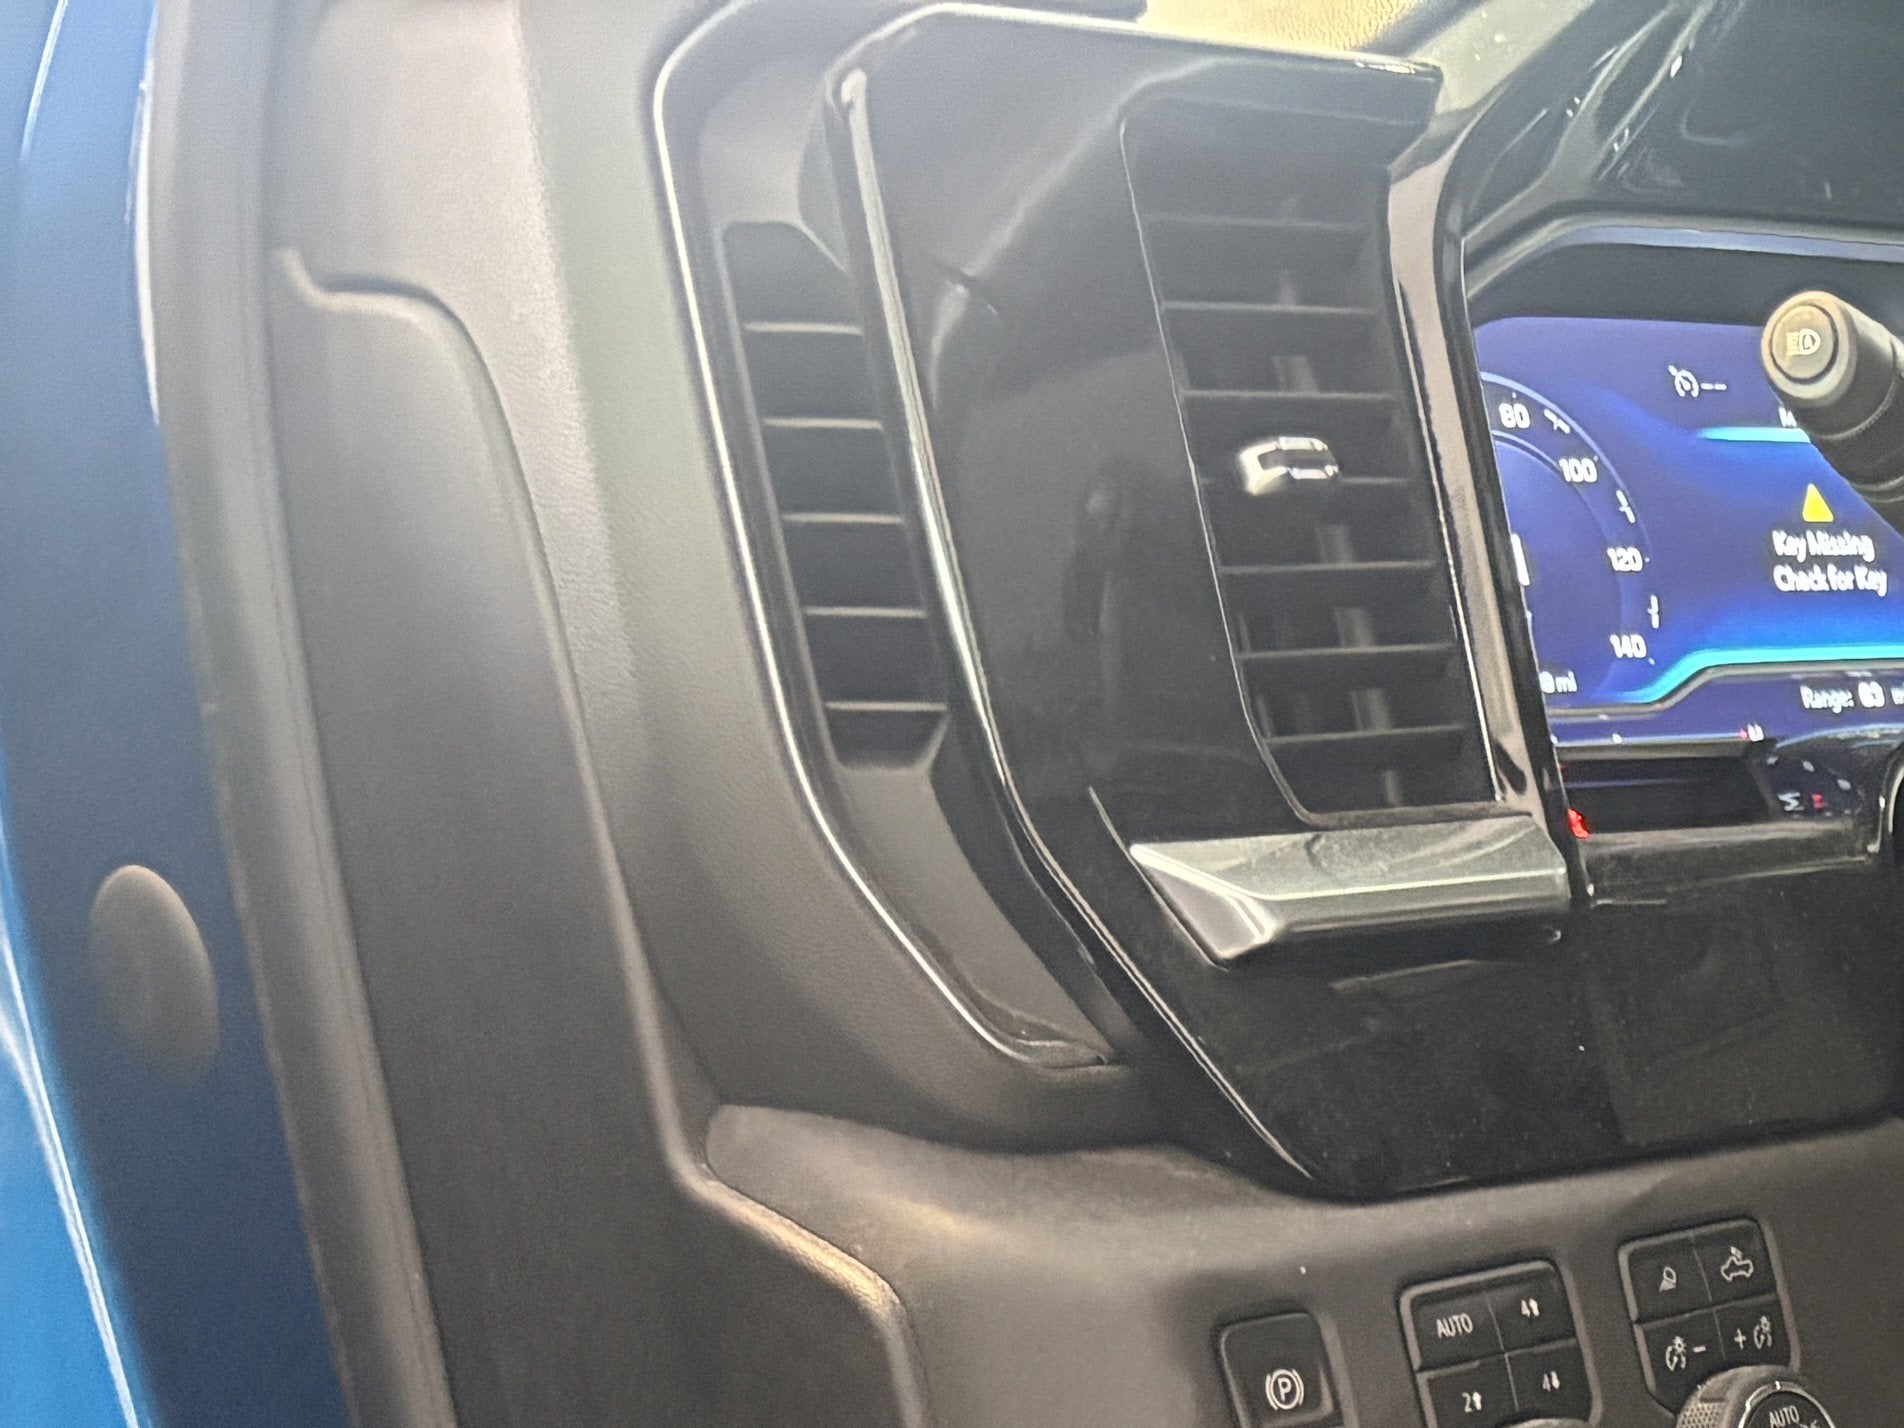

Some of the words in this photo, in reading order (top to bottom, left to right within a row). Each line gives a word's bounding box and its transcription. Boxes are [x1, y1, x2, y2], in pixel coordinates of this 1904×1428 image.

[1499, 402, 1530, 429] 80
[1559, 457, 1598, 483] 100
[1607, 546, 1643, 572] 120
[1772, 529, 1806, 562] Key
[1806, 529, 1875, 562] Missing
[1773, 563, 1829, 591] Check
[1827, 563, 1855, 591] for
[1854, 563, 1887, 597] Key
[1609, 634, 1647, 659] 140
[1800, 685, 1855, 713] Range:
[1436, 1312, 1474, 1340] AUTO
